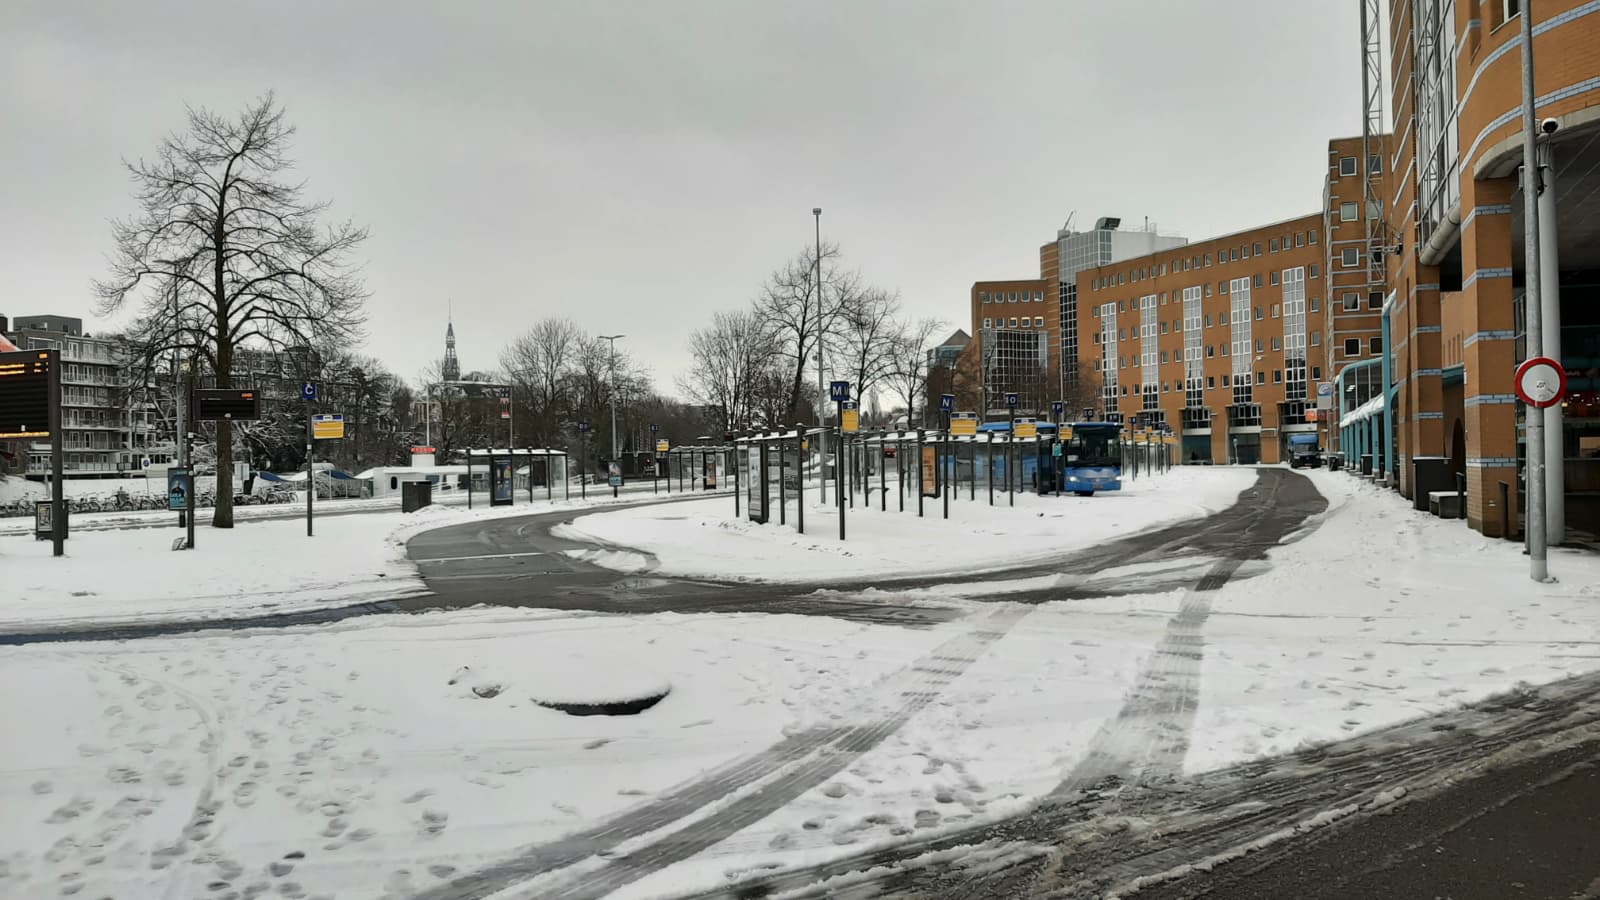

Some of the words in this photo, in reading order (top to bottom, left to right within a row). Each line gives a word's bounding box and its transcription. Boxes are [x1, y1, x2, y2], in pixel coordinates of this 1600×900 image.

[305, 385, 313, 395] C
[832, 386, 842, 396] M
[942, 399, 949, 407] N
